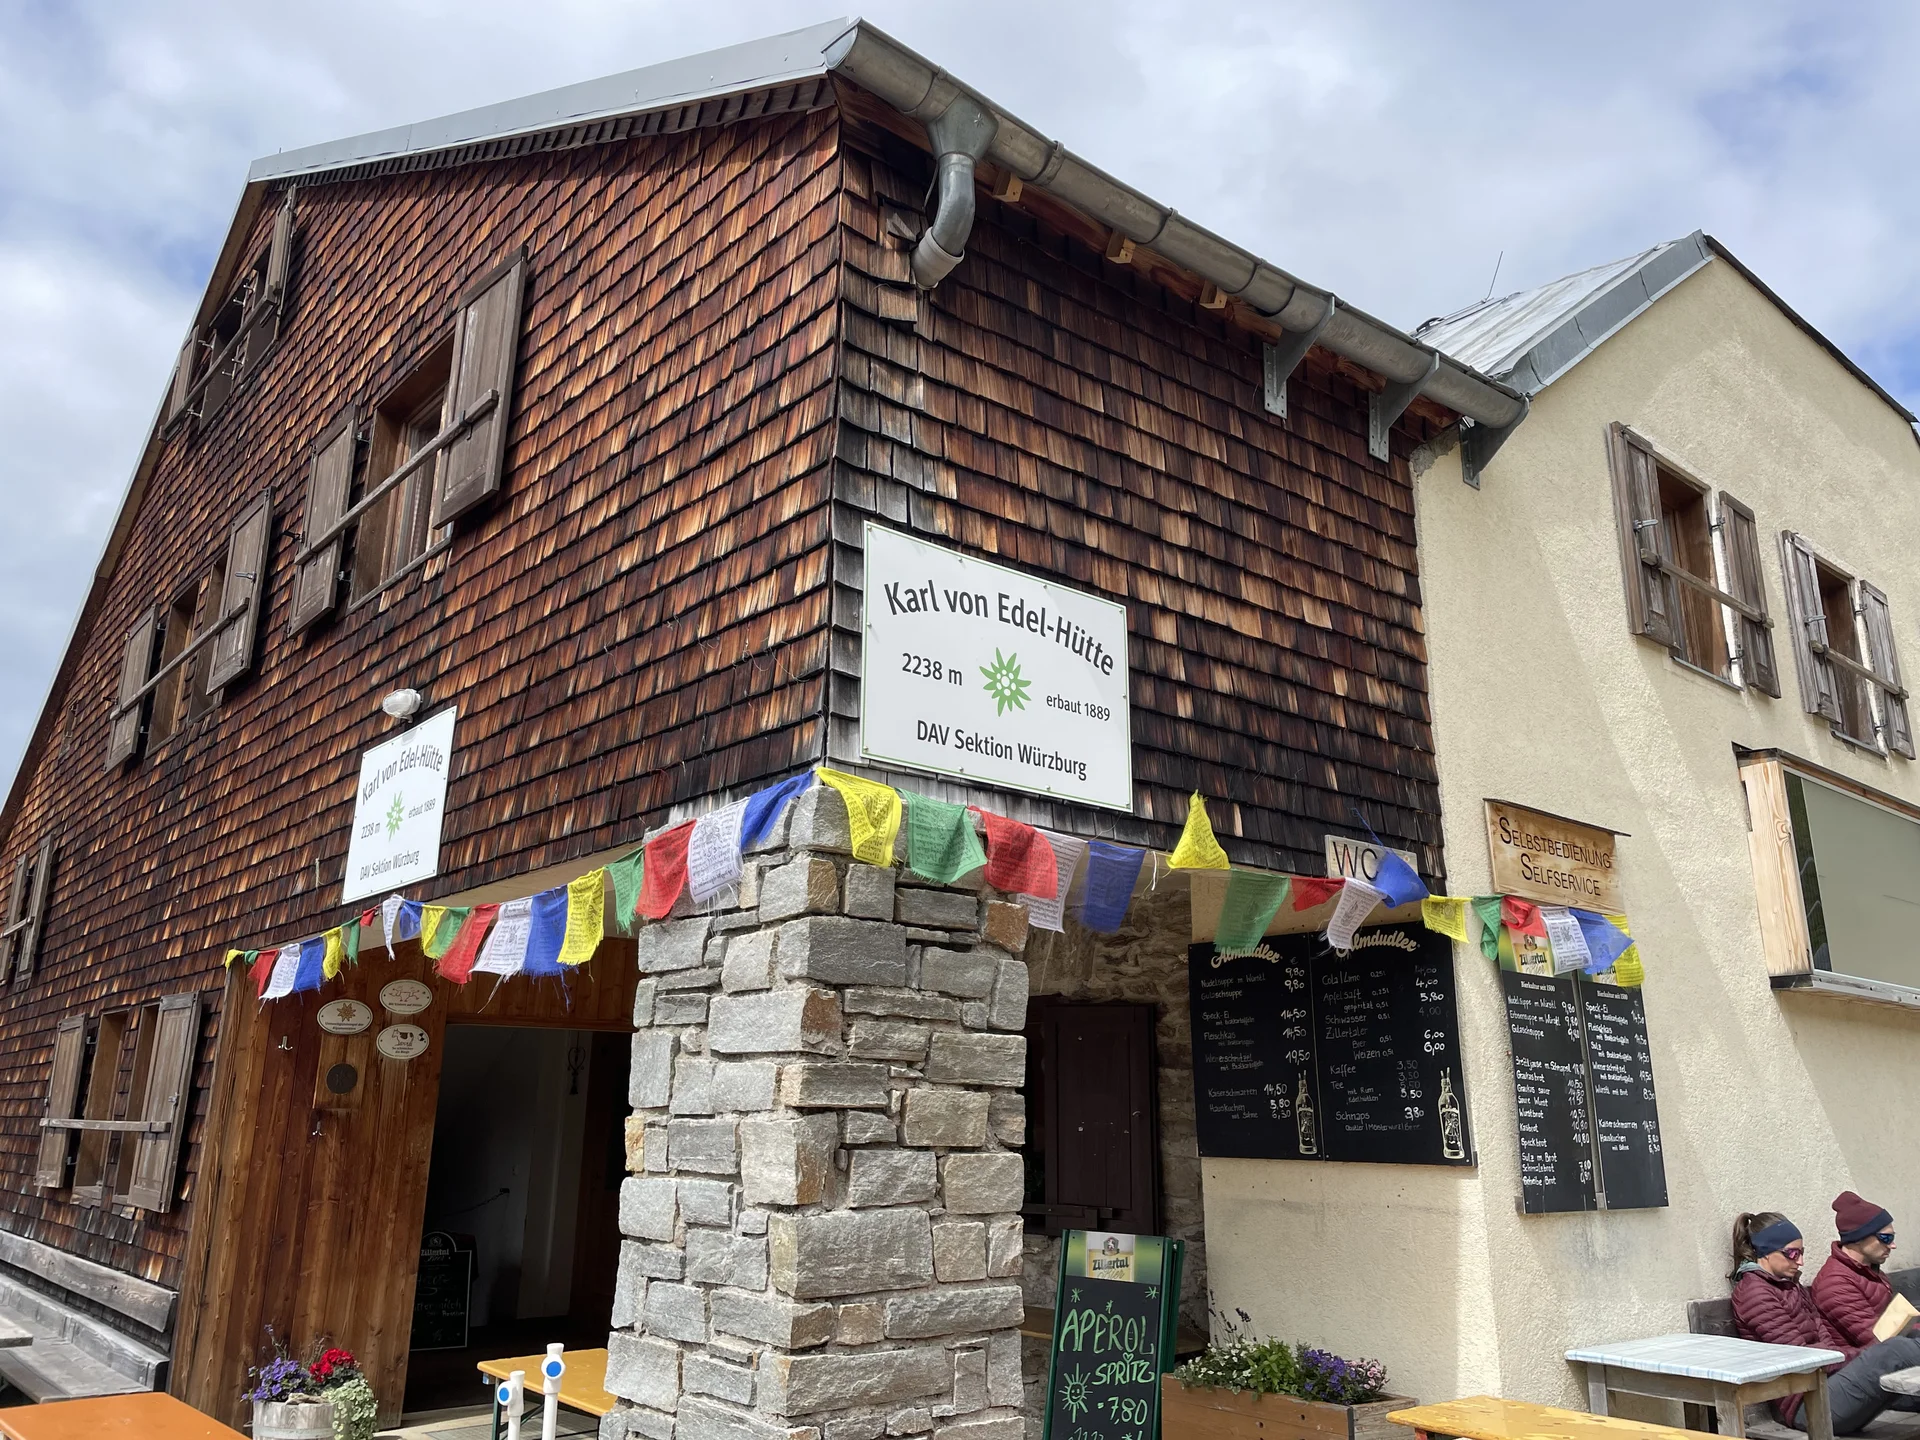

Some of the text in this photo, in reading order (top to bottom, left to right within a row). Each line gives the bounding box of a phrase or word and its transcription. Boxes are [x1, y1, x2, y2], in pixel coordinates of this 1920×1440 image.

[884, 579, 1114, 676] Karl von Edel-Hütte
[902, 653, 963, 686] 2238 m
[1046, 693, 1110, 722] erbaut 1889
[917, 720, 1088, 781] DAV Sektion Würzburg
[362, 744, 444, 806] Karl von Edel-Hütte
[408, 798, 437, 818] erbaut 1889
[360, 822, 375, 839] 2238
[1499, 816, 1612, 869] SELBSTBEDIENUNG
[360, 850, 420, 880] DAV Sektion Würzburg
[1333, 841, 1378, 881] WC
[1520, 853, 1602, 896] SELFSERVICE
[1211, 943, 1281, 968] Almdudler
[1285, 967, 1305, 979] 9,80
[1284, 979, 1304, 993] 9,80
[1416, 977, 1438, 989] 4,00
[1420, 991, 1444, 1003] 5,80
[1280, 1008, 1307, 1022] 14,50
[1418, 1006, 1441, 1018] 4,00
[1282, 1026, 1307, 1040] 14,50
[1326, 1026, 1368, 1040] Zillertaler
[1424, 1029, 1445, 1040] 6,00
[1286, 1050, 1310, 1066] 19,50
[1353, 1049, 1381, 1061] Weizen
[1424, 1042, 1446, 1057] 6,00
[1330, 1063, 1357, 1078] Kaffee
[1264, 1082, 1288, 1097] 14,50
[1330, 1080, 1345, 1090] Tee
[1272, 1109, 1292, 1120] 6,30
[1336, 1106, 1424, 1125] Schnaps 3,80
[1544, 1152, 1558, 1162] Brot
[1060, 1308, 1155, 1355] APEROL
[1107, 1396, 1149, 1426] 7,80
